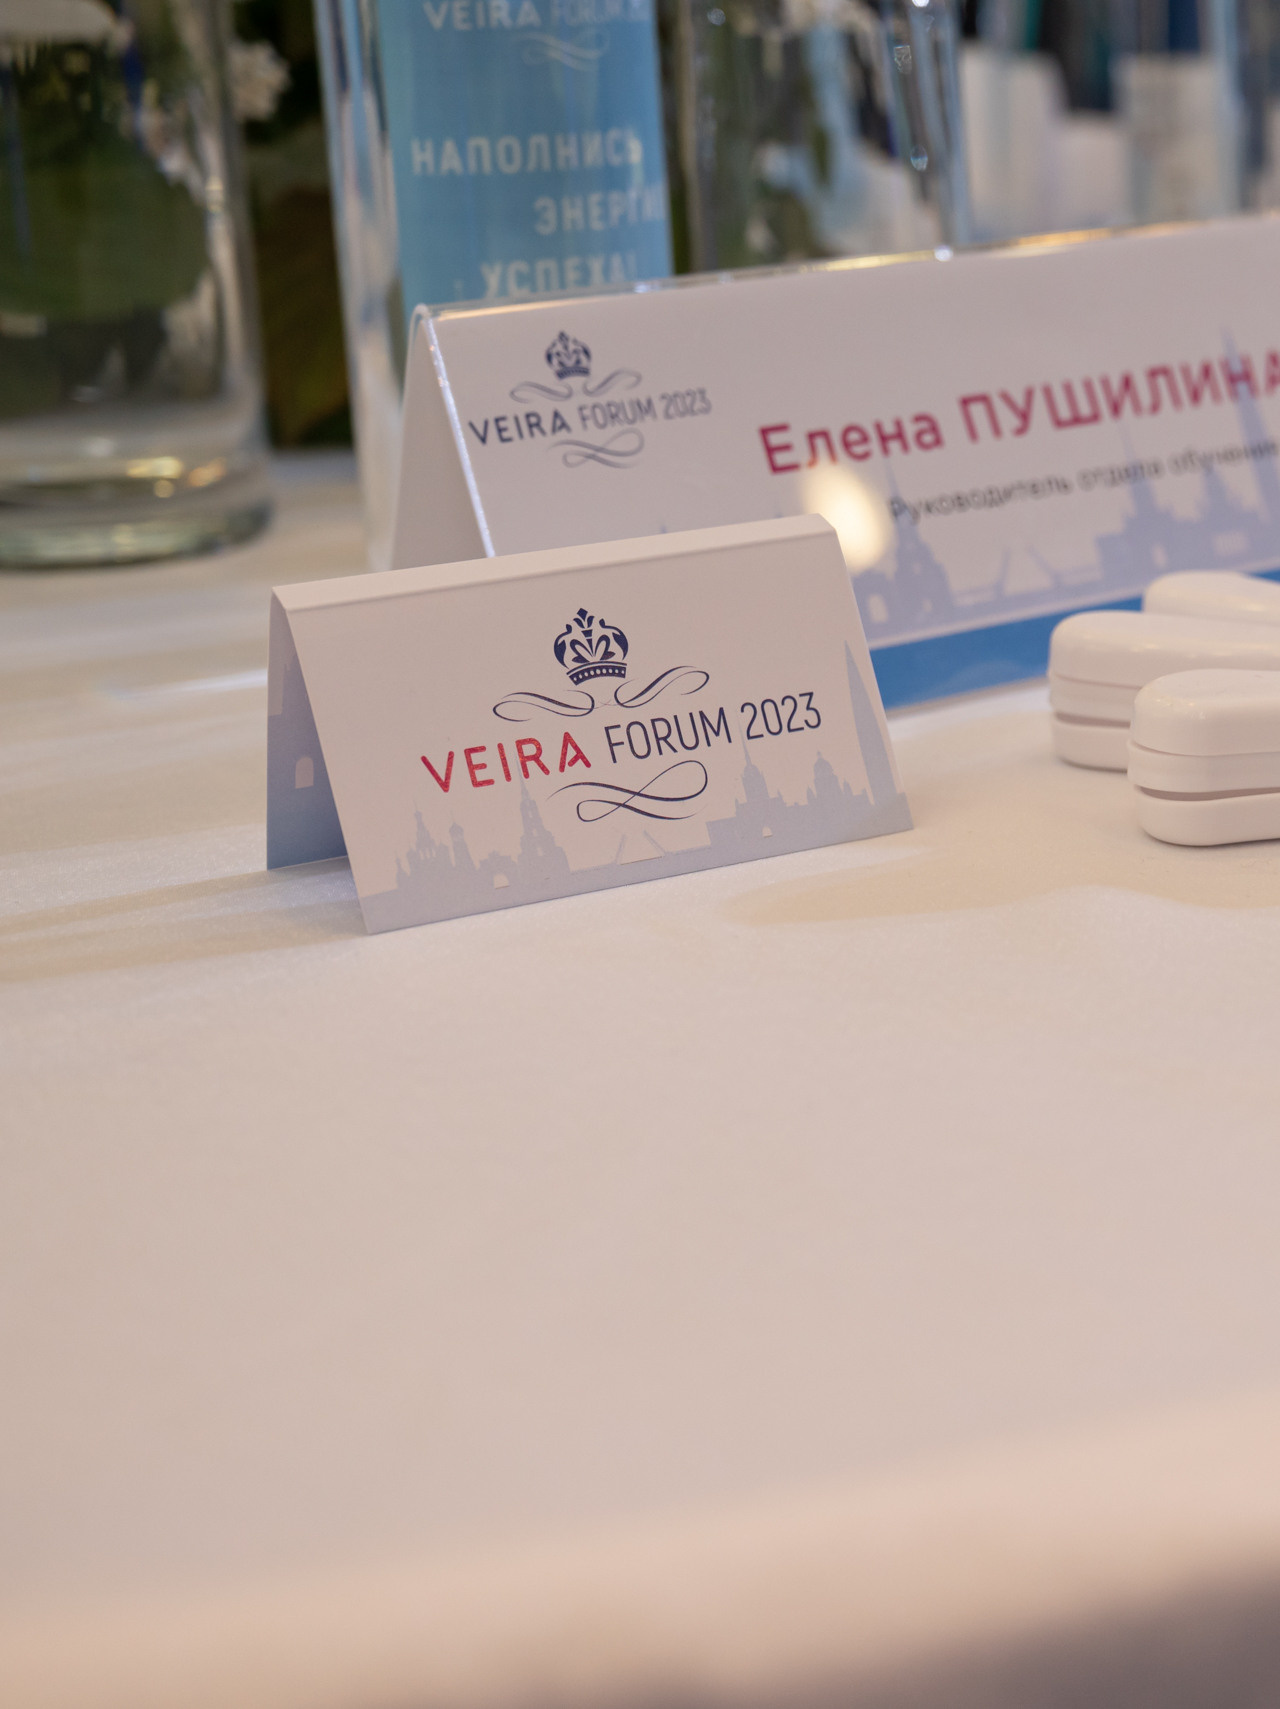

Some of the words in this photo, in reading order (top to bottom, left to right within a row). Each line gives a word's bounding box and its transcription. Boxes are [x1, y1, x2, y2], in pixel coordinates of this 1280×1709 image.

[422, 0, 542, 31] VEIRA
[410, 127, 644, 177] НАПОЛНИСЬ
[468, 408, 573, 446] VEIRA
[576, 397, 659, 432] FORUM
[661, 387, 714, 420] 2023
[757, 411, 946, 476] Елена
[420, 731, 592, 794] VEIRA
[603, 706, 733, 764] FORUM
[740, 691, 823, 741] 2023
